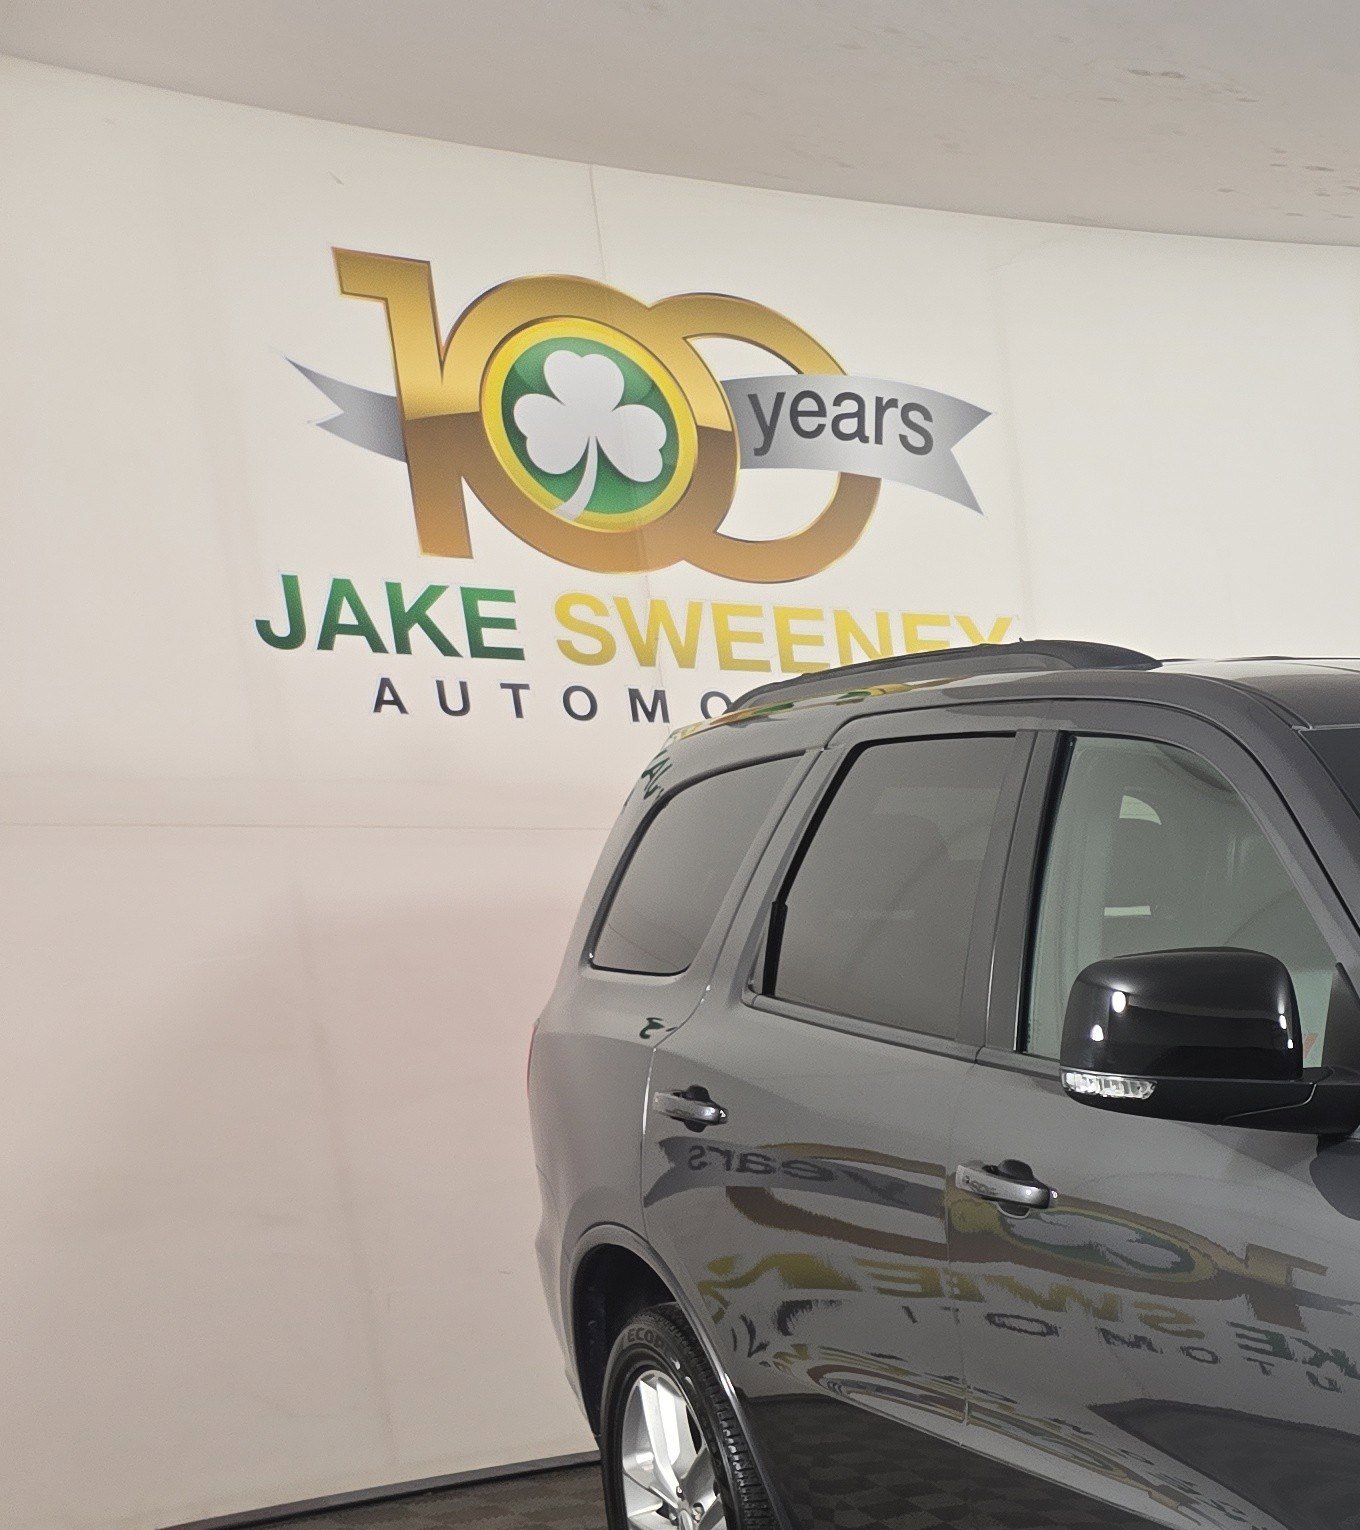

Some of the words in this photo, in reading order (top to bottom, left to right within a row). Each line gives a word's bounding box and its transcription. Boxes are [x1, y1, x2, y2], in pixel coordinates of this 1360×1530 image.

[331, 246, 881, 585] 100
[747, 388, 936, 456] years
[255, 574, 526, 662] JAKE
[372, 677, 734, 723] AUTOMO
